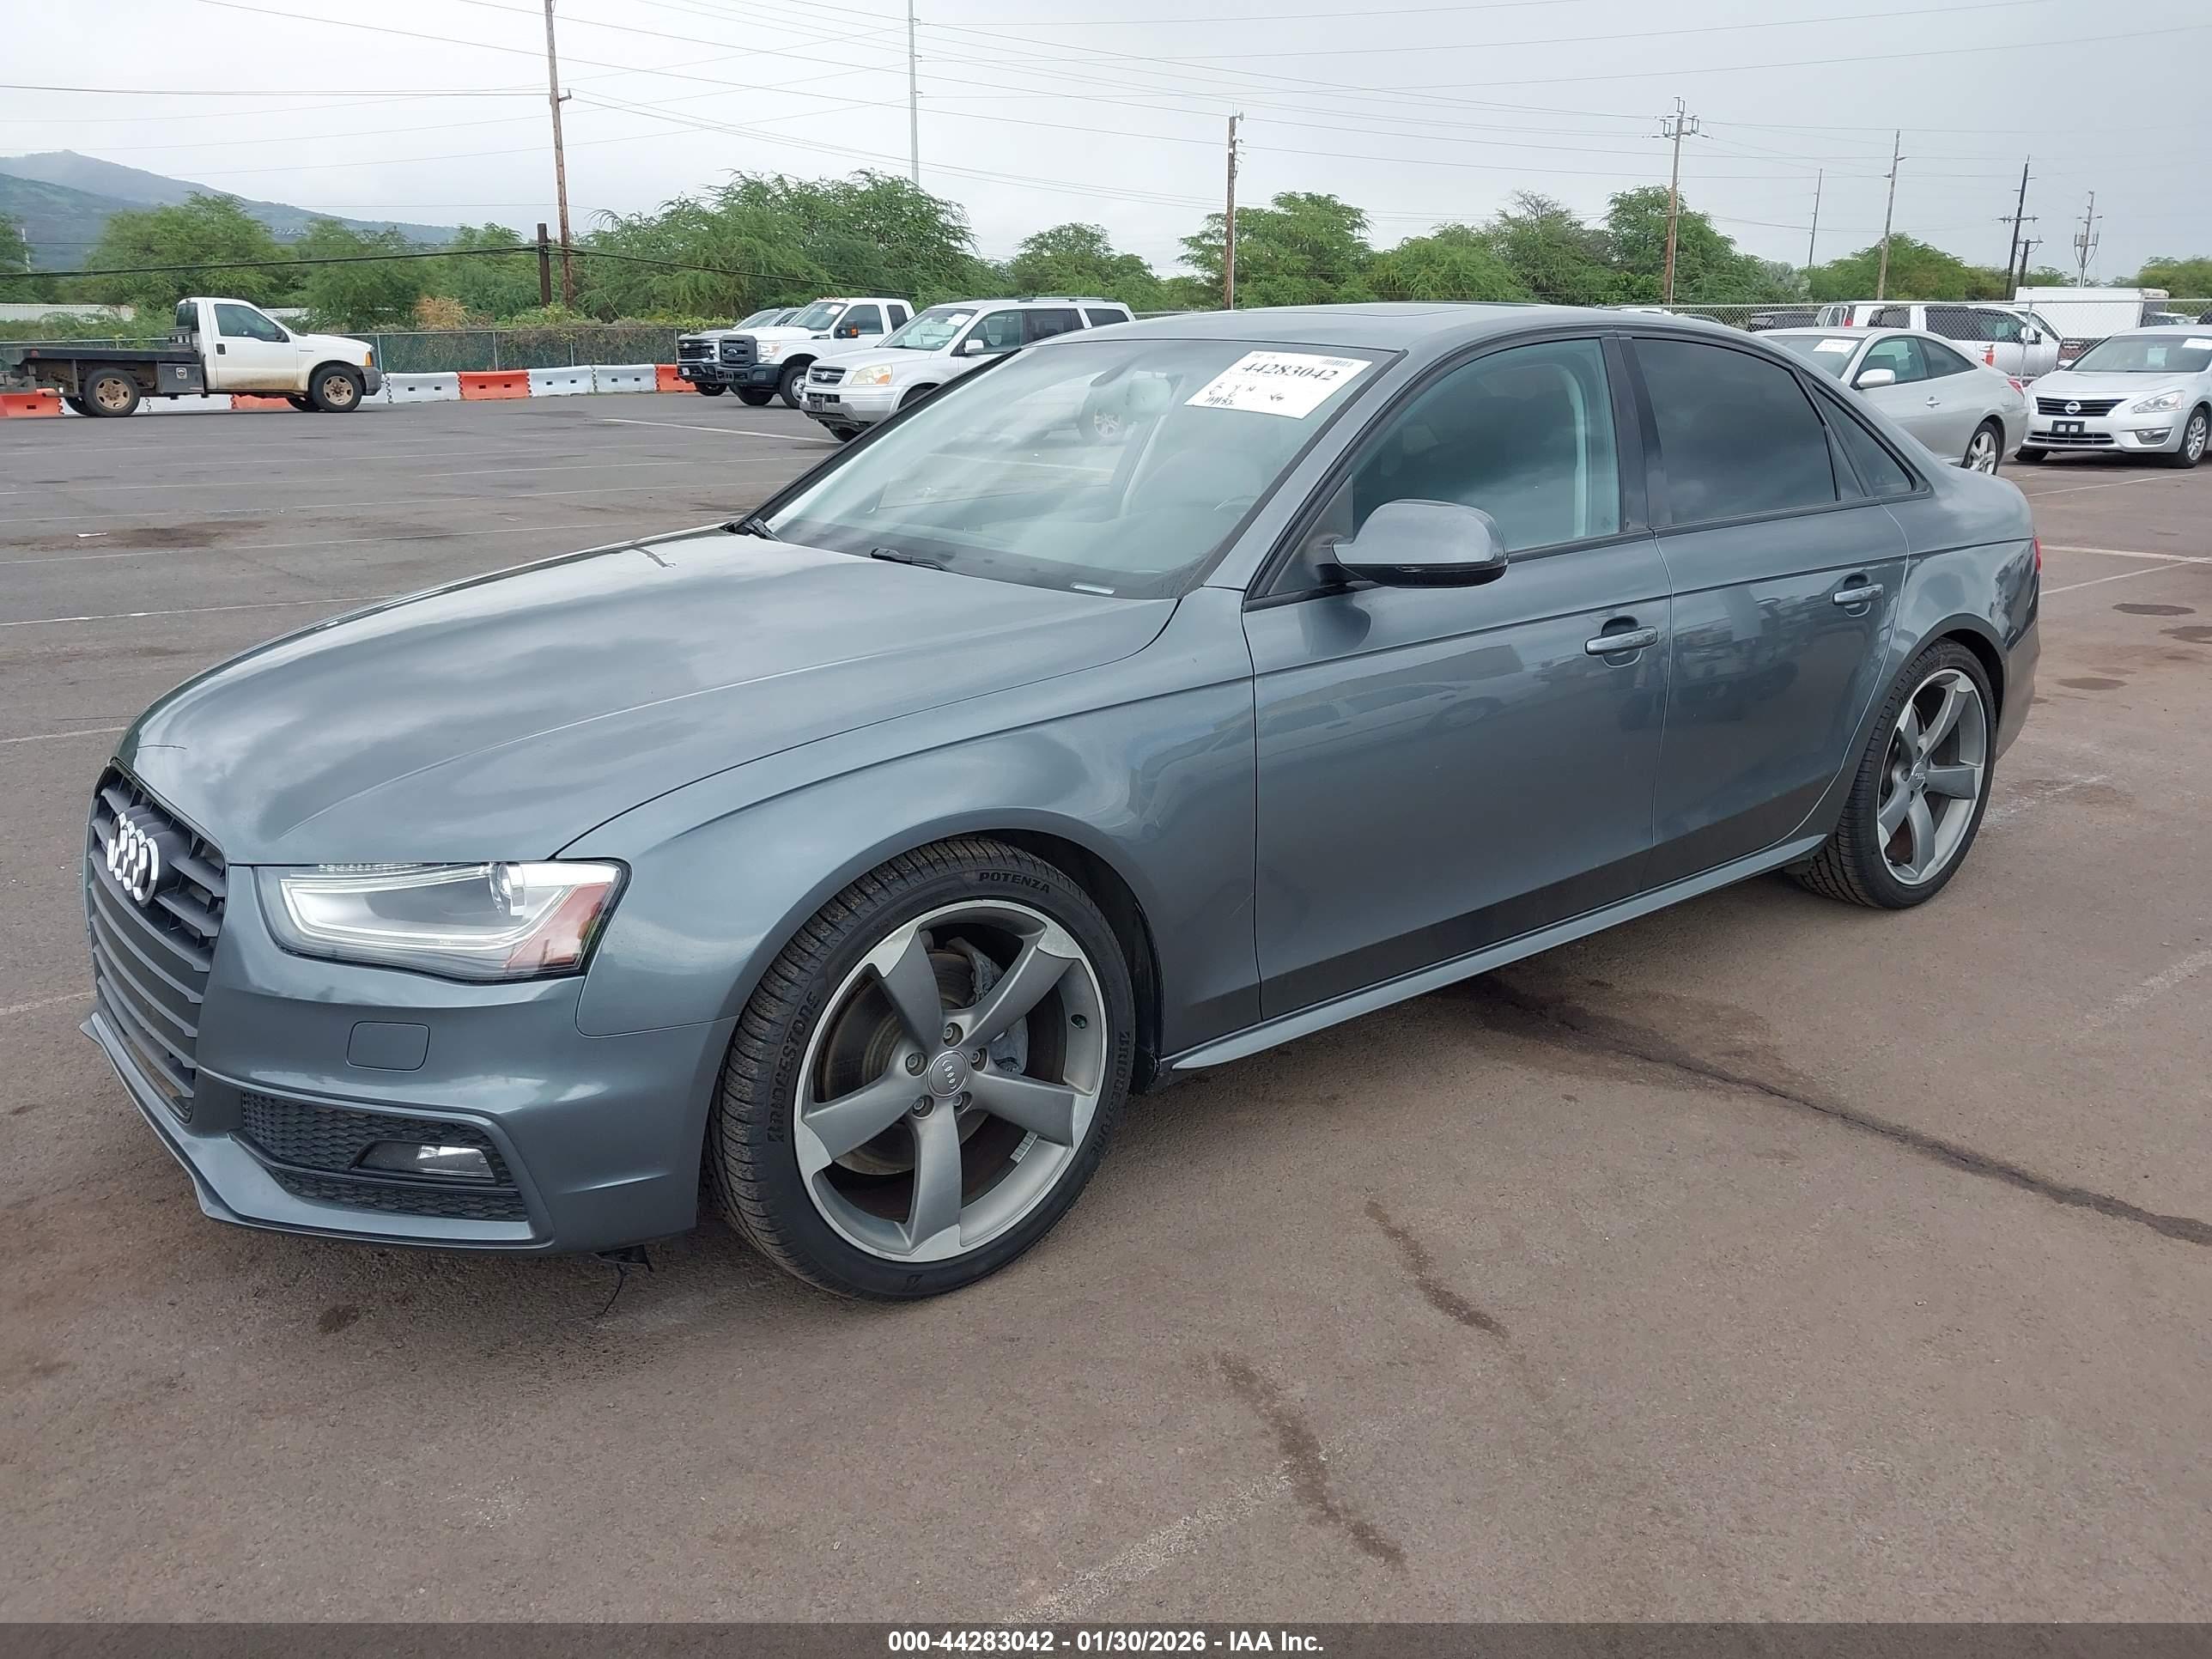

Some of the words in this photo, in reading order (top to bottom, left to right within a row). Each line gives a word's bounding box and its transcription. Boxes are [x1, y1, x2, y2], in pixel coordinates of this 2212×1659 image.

[1242, 362, 1340, 381] 44283042
[978, 871, 1051, 894] POTENZA
[767, 989, 821, 1143] BRIDGESTONE
